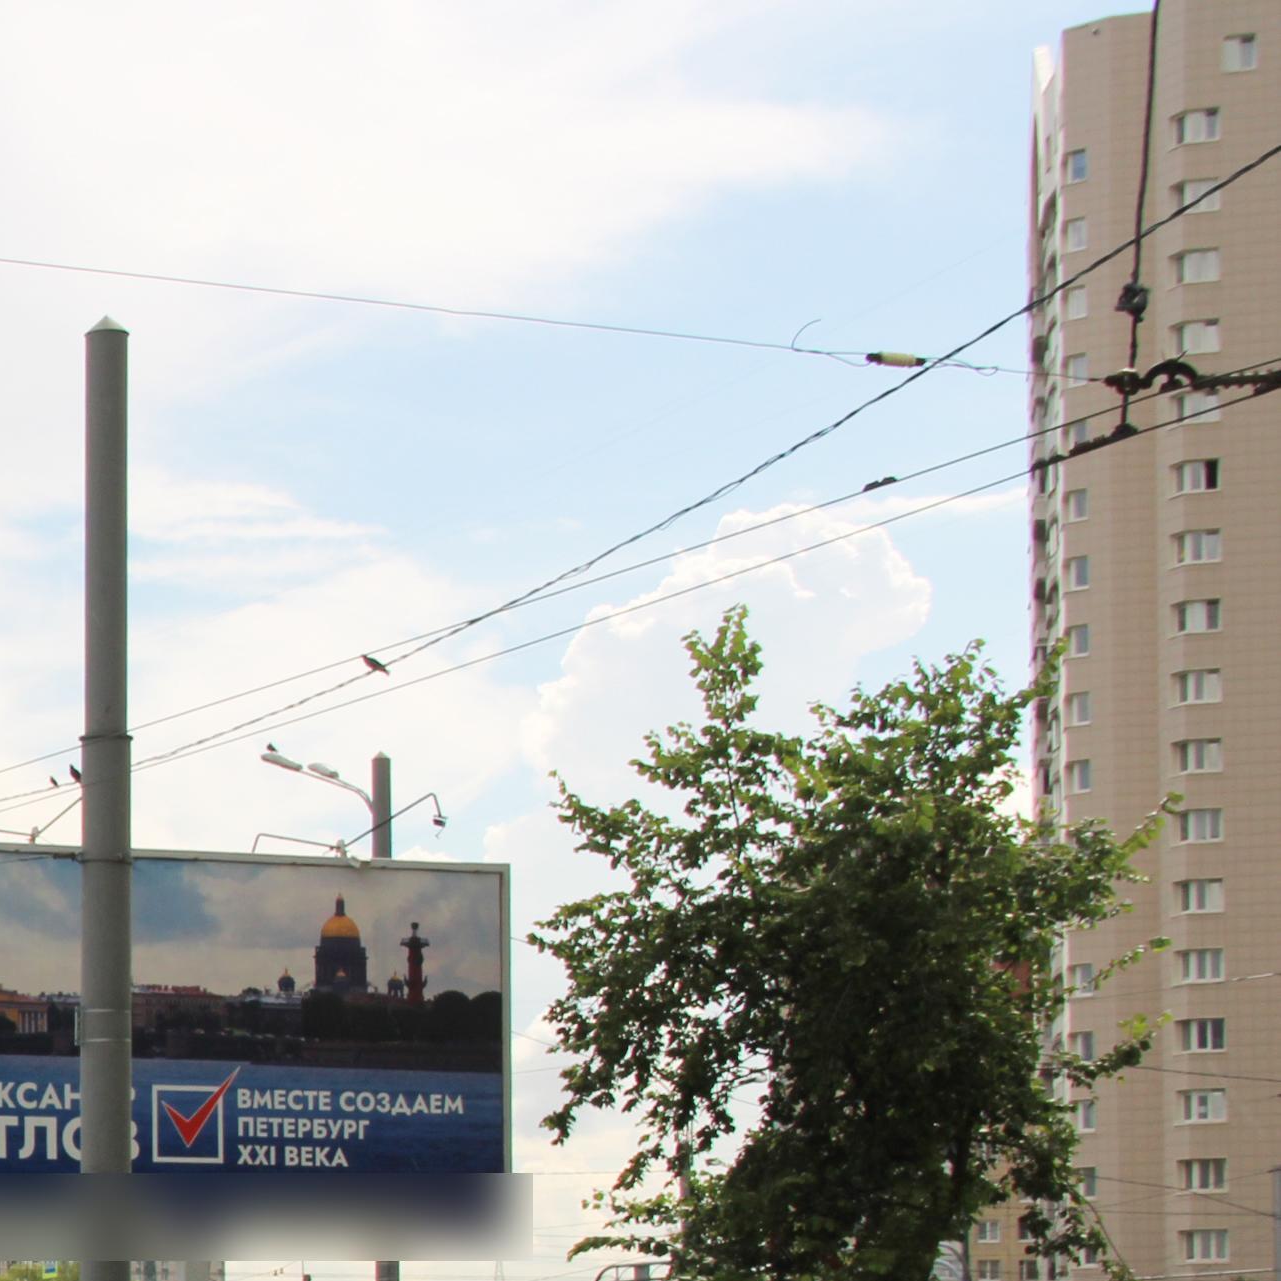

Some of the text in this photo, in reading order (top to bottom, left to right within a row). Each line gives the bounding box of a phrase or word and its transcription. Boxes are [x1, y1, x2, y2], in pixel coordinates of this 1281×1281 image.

[237, 1088, 464, 1115] ВМЕСТЕ СОЗДАЕМ
[237, 1118, 370, 1141] ПЕТЕРБУРГ
[284, 1145, 349, 1168] ВЕКА
